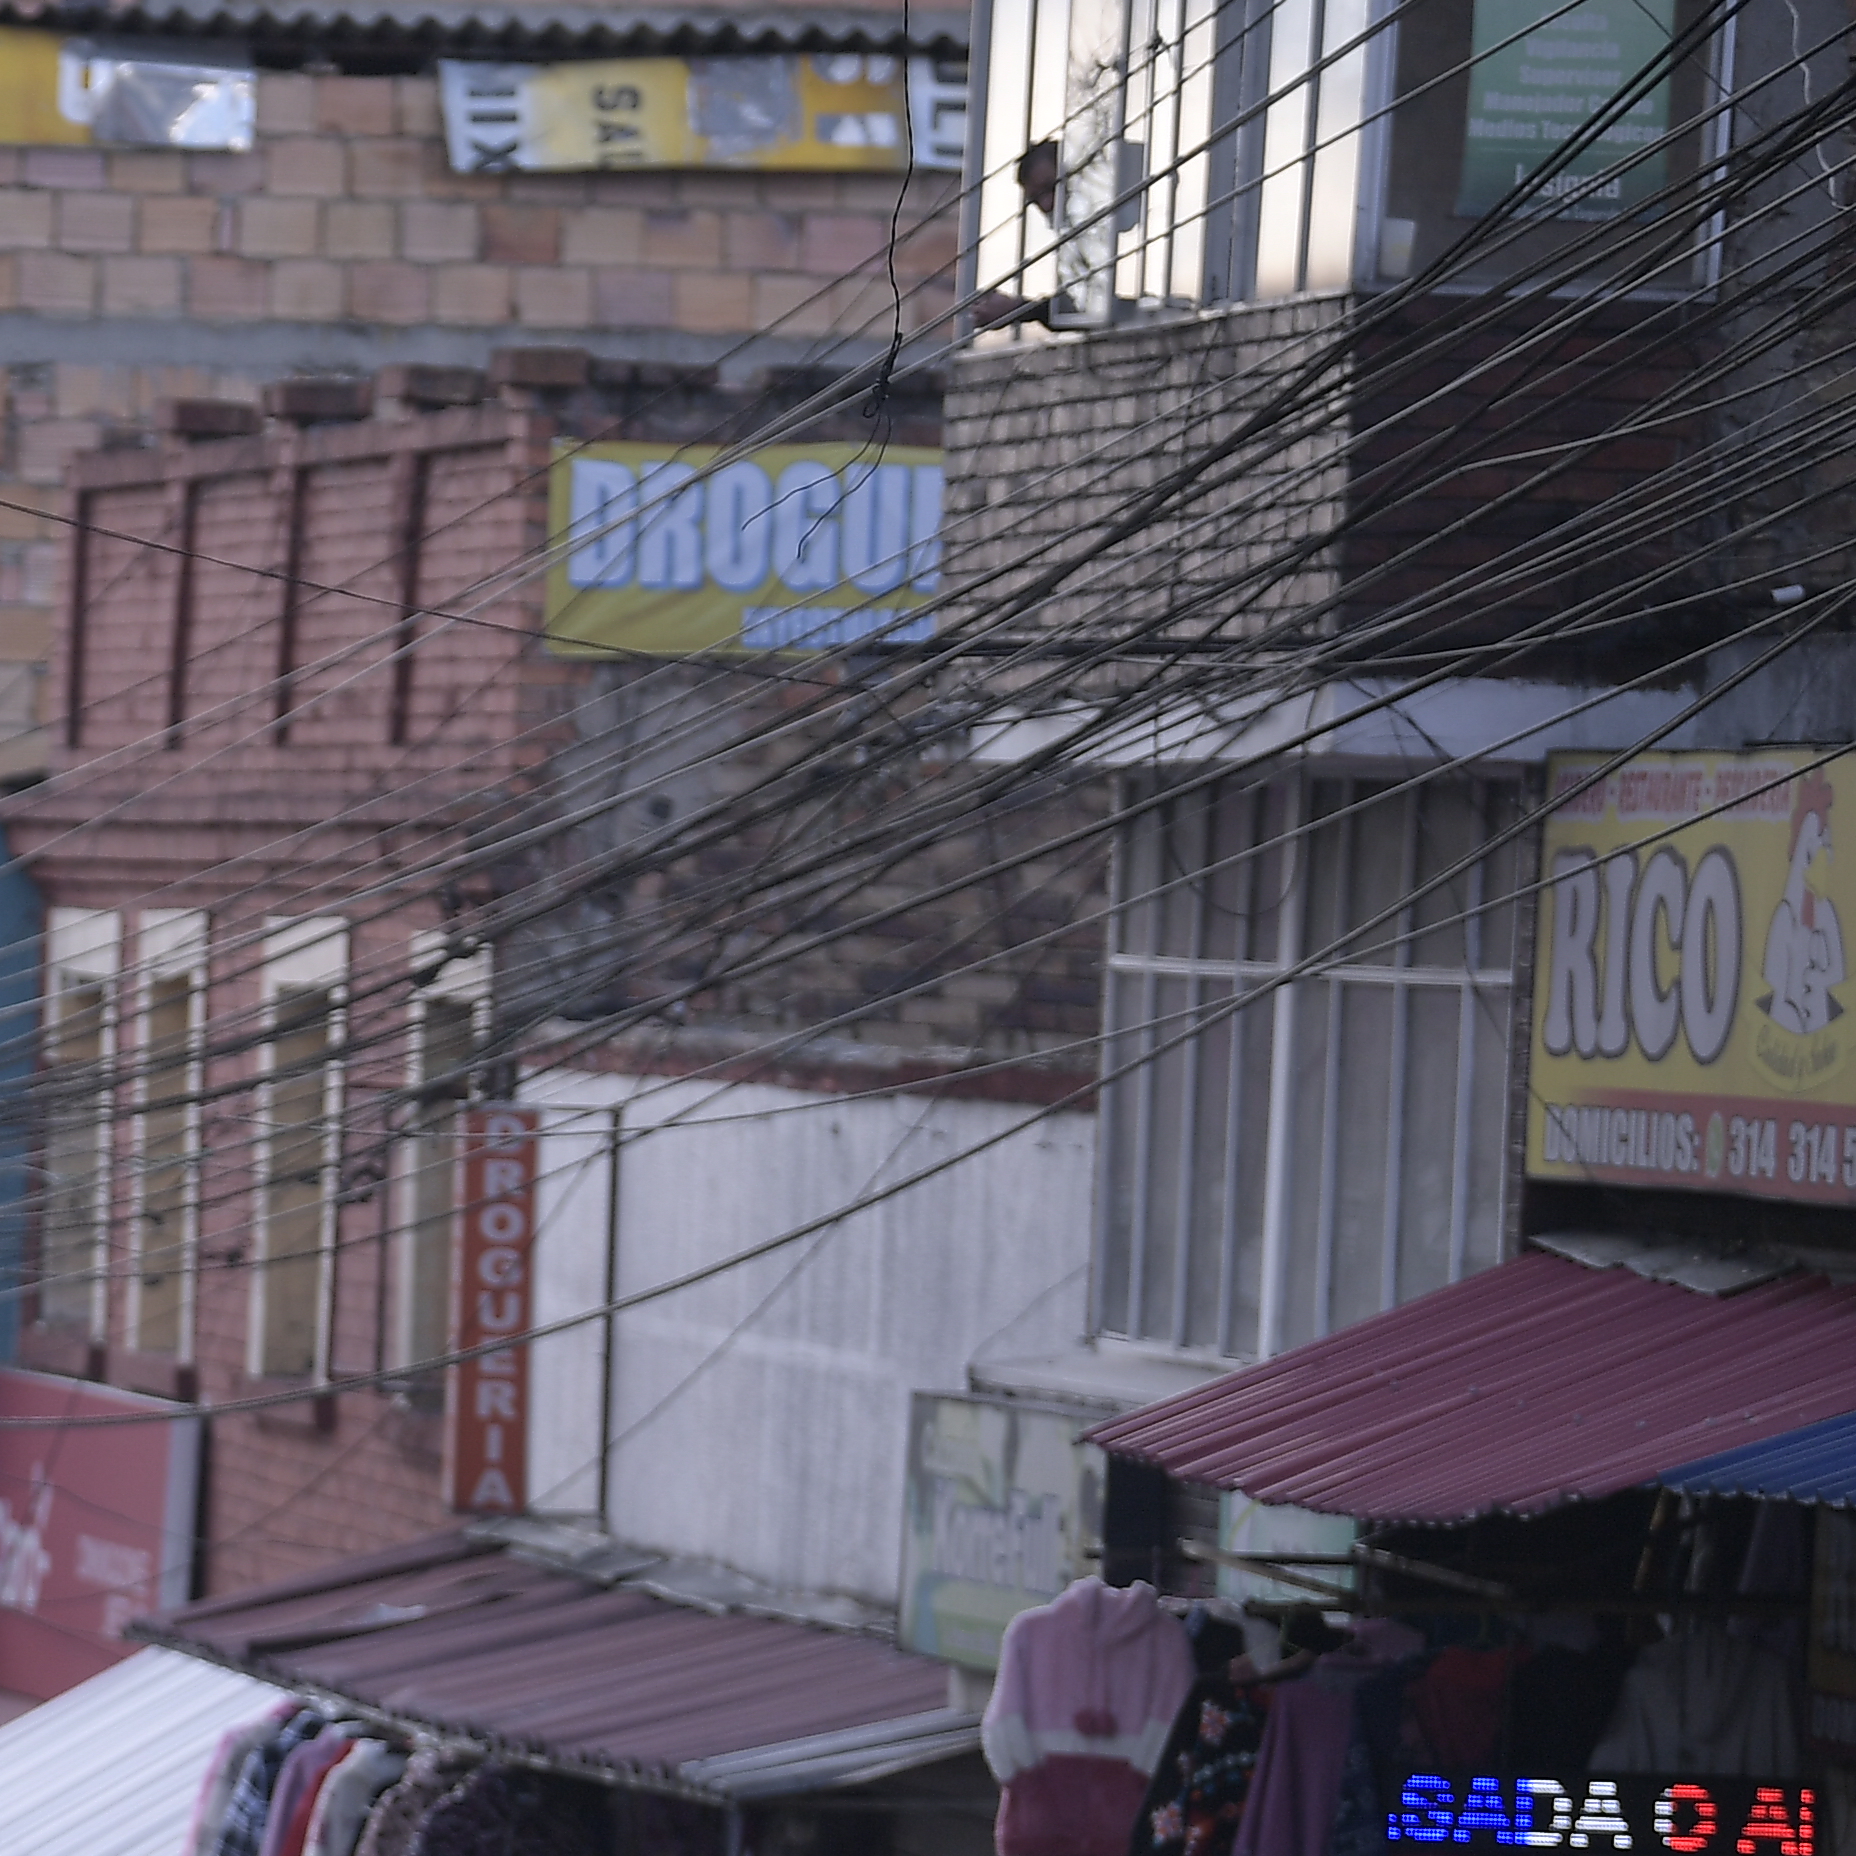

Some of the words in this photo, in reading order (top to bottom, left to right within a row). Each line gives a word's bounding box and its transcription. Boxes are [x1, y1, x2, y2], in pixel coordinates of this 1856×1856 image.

[1543, 845, 1742, 1067] RICO
[1728, 1115, 1778, 1178] 314
[1789, 1120, 1838, 1184] 314
[471, 1114, 526, 1502] DROGUERIA
